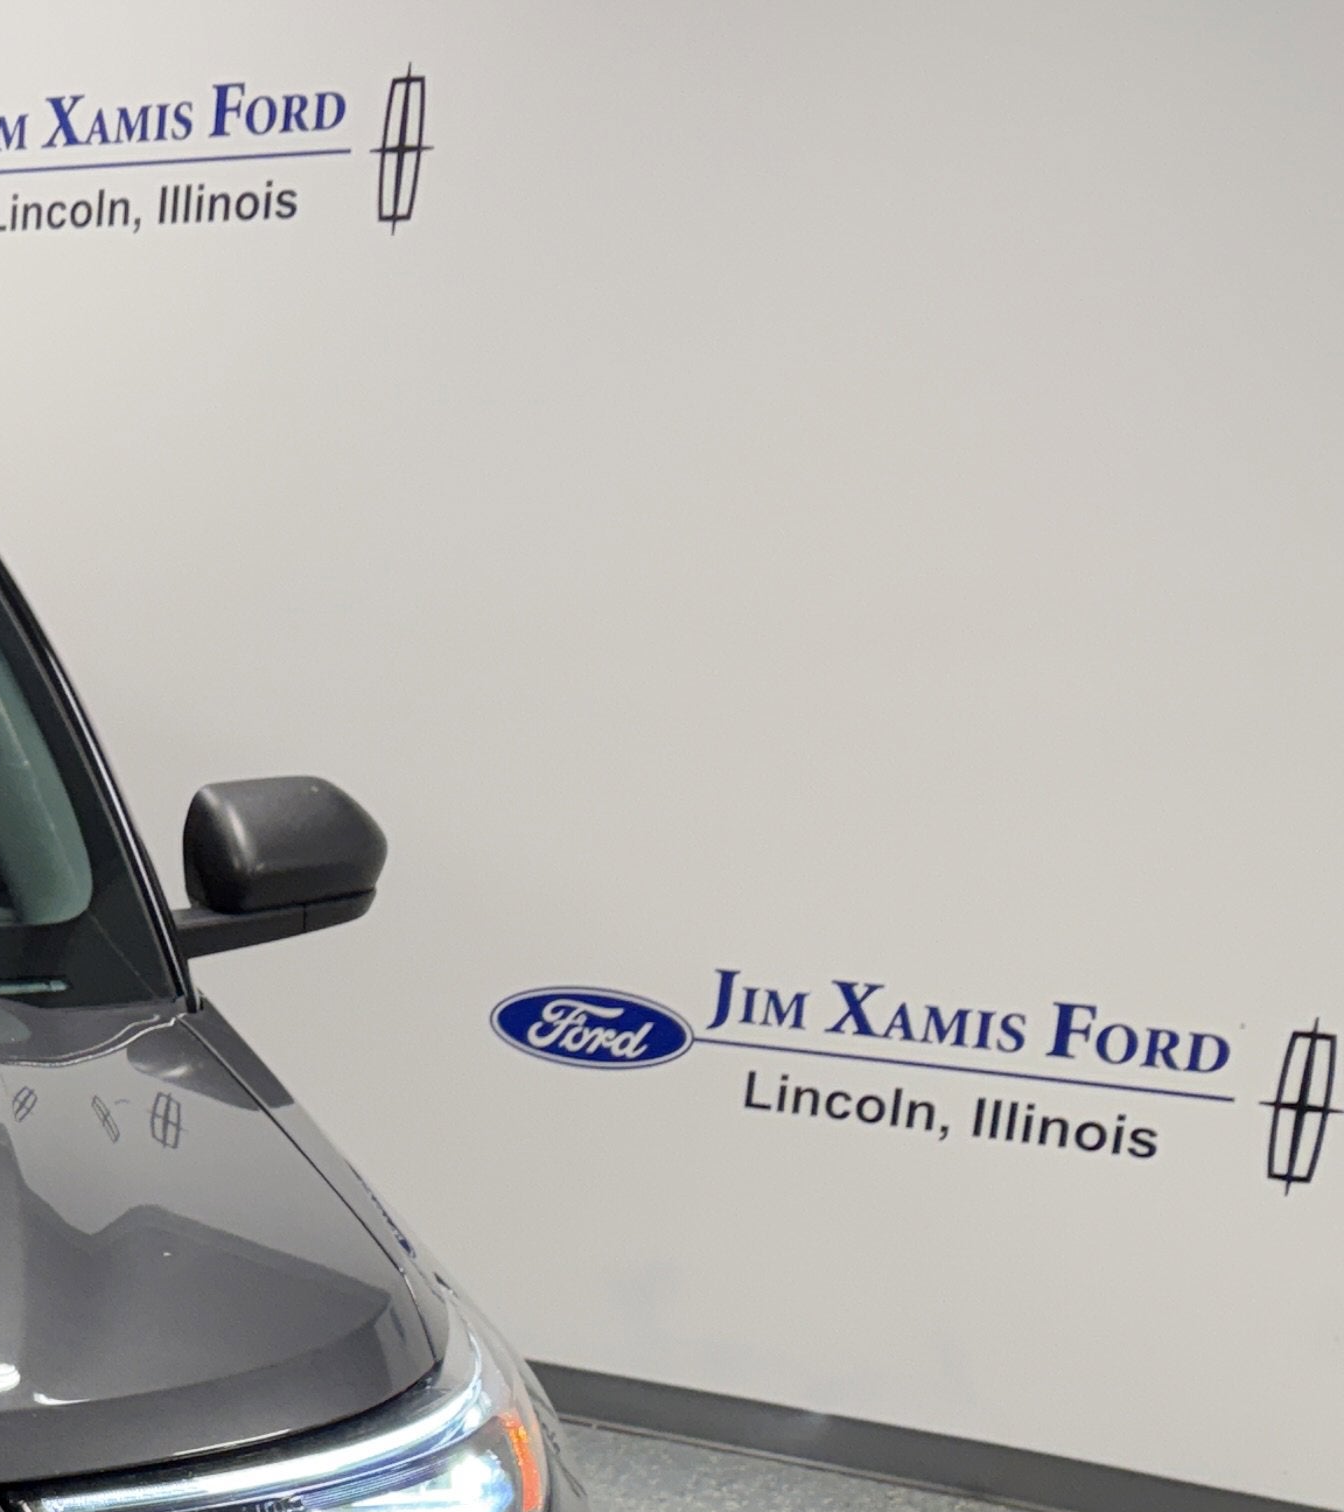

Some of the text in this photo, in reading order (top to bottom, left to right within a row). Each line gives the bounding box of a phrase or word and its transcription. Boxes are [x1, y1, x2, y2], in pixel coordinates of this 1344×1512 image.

[41, 94, 194, 151] XAMIS
[208, 81, 347, 137] FORD
[157, 180, 298, 225] Illinois
[527, 1002, 650, 1060] Ford
[706, 968, 1231, 1075] JIM XAMIS FORD
[743, 1070, 1160, 1160] Lincoln, Illinois
